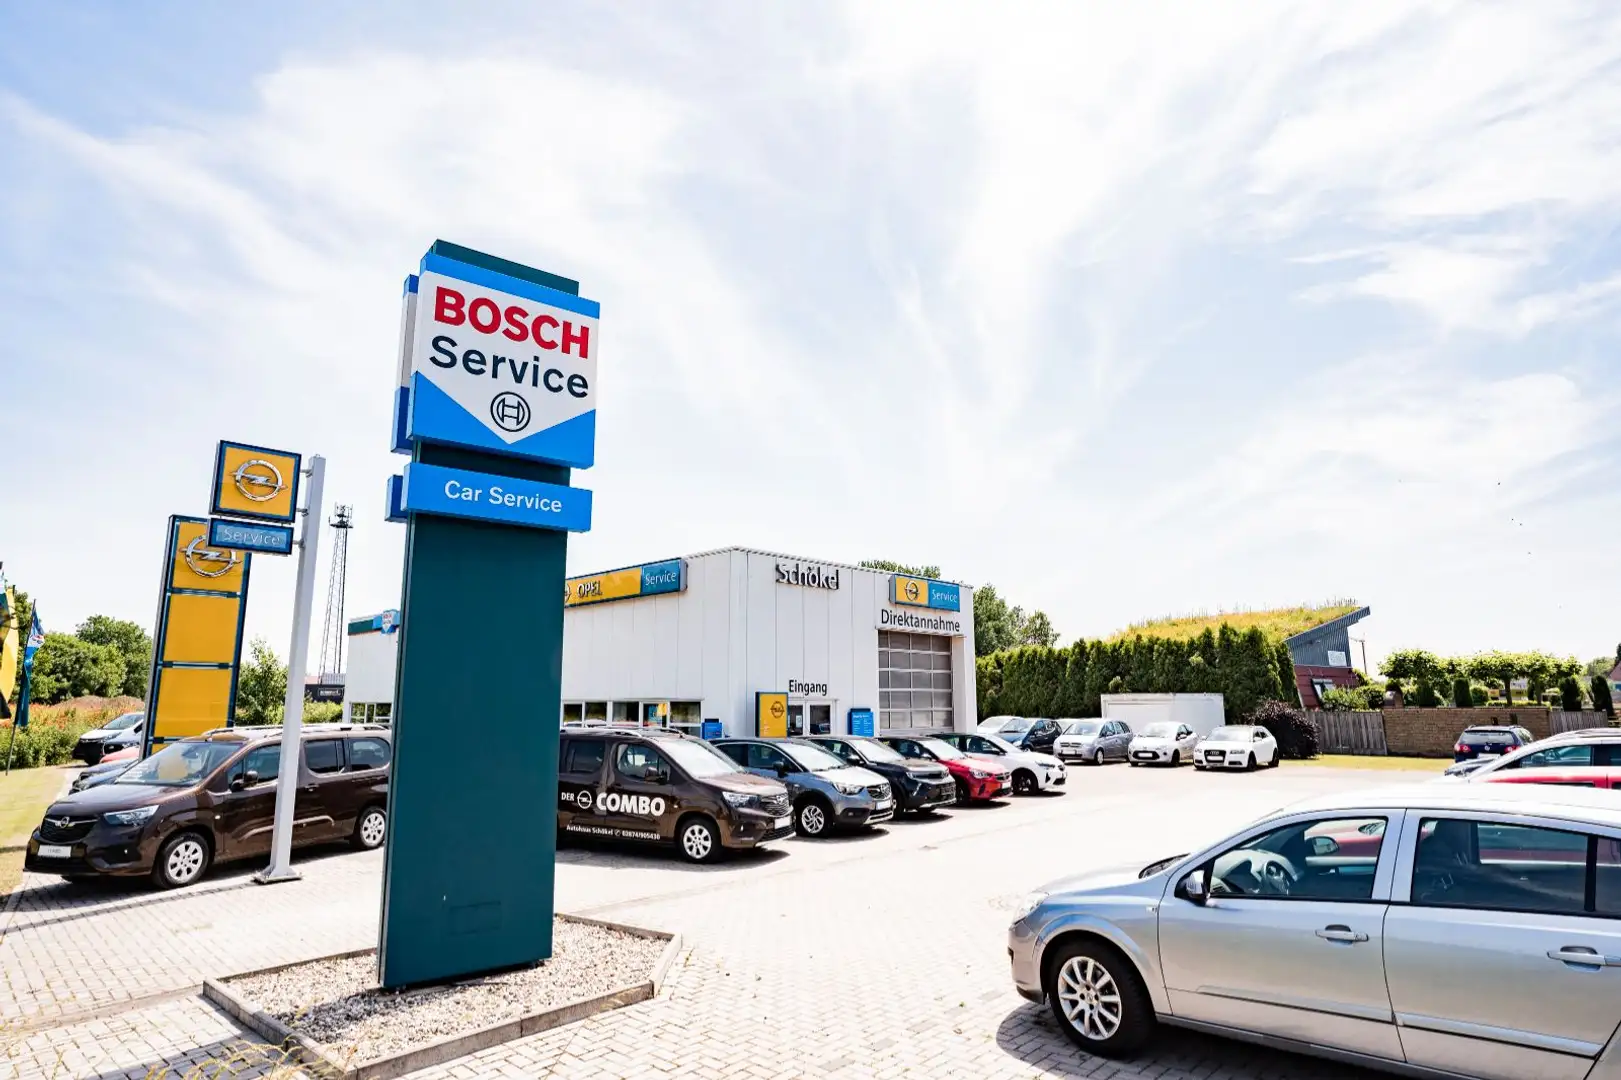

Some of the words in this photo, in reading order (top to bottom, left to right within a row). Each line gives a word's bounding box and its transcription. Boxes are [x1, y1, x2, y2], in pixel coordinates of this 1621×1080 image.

[434, 286, 589, 359] BOSCH
[429, 336, 589, 398] Service
[444, 480, 482, 502] Car
[489, 486, 562, 512] Service
[224, 528, 280, 545] Service
[577, 580, 602, 598] OPEL
[645, 571, 677, 586] Service
[776, 563, 839, 590] Schökel
[932, 589, 958, 603] Service
[881, 609, 960, 632] Direktannahme
[789, 680, 828, 696] Eingang
[561, 792, 575, 802] DER
[596, 792, 666, 817] COMBO
[566, 825, 592, 833] Autohaus
